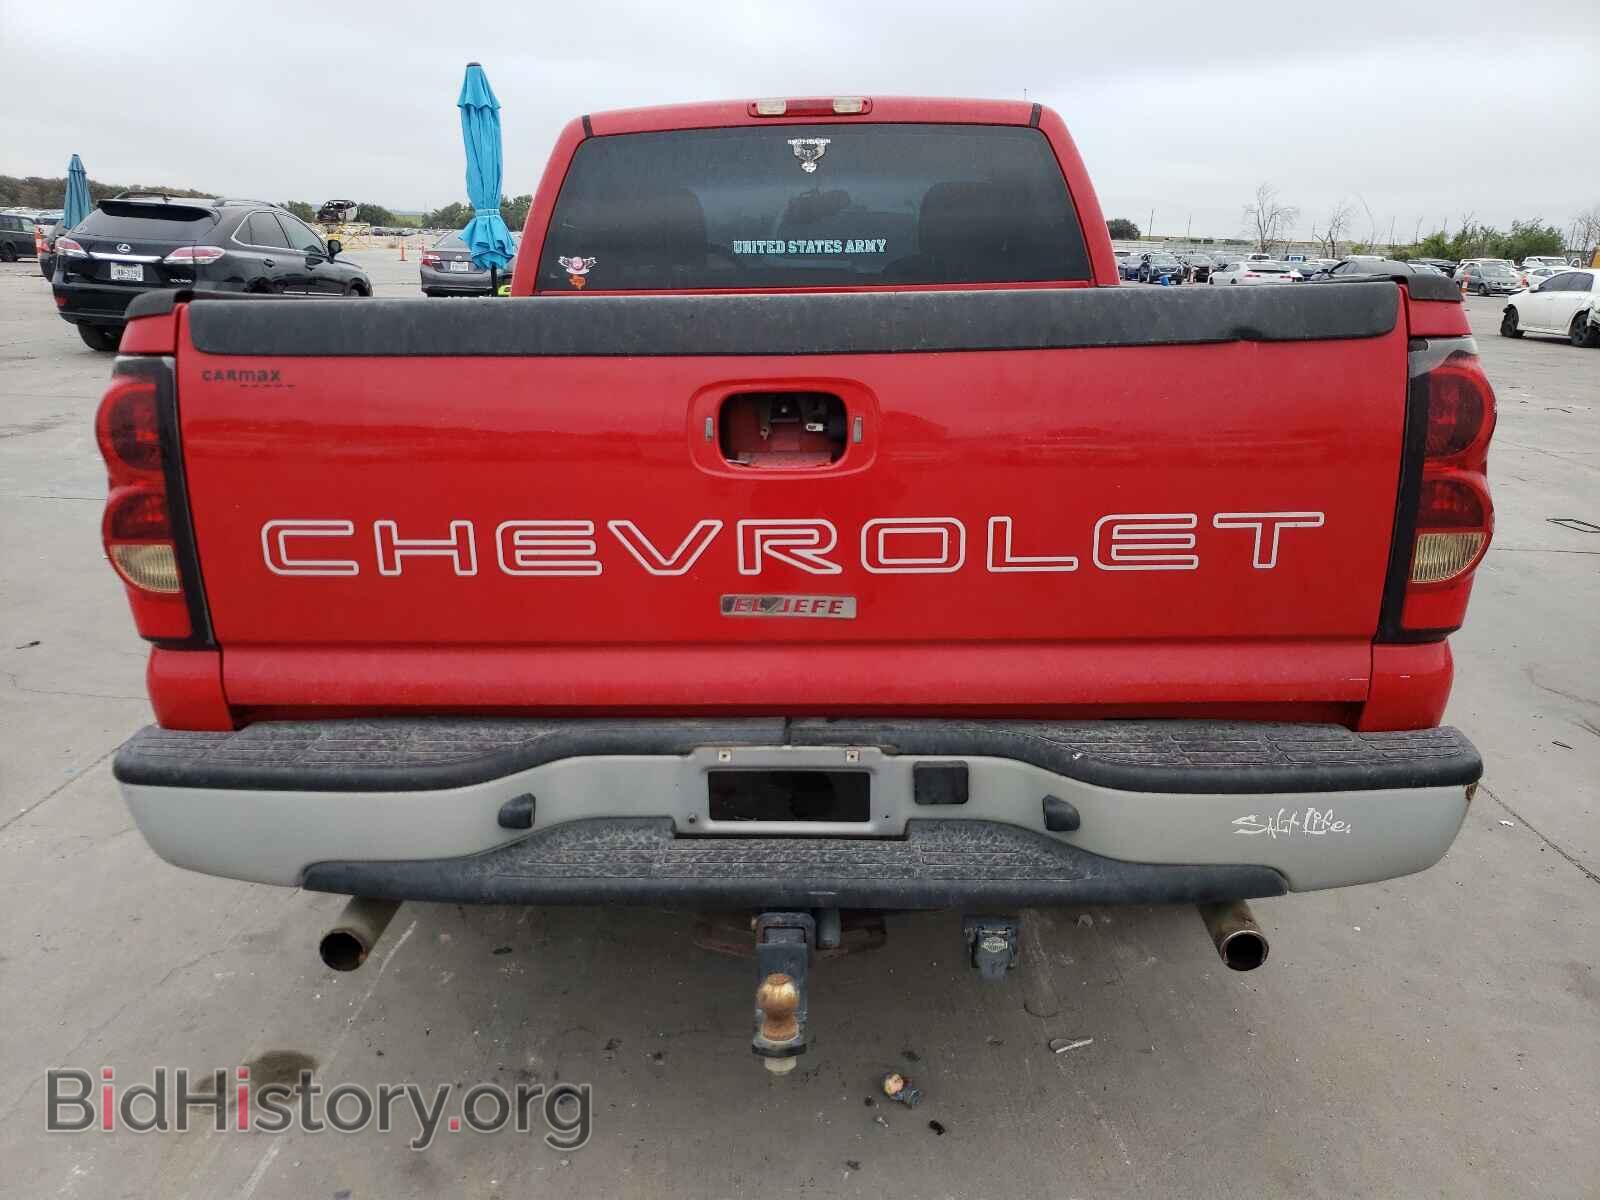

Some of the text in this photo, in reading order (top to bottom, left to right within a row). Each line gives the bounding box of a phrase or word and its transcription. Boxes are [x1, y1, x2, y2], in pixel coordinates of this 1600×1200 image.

[733, 238, 887, 254] UNITED STATES ARMY
[261, 511, 1325, 576] CHEVROLET
[734, 598, 844, 614] EL JEFE
